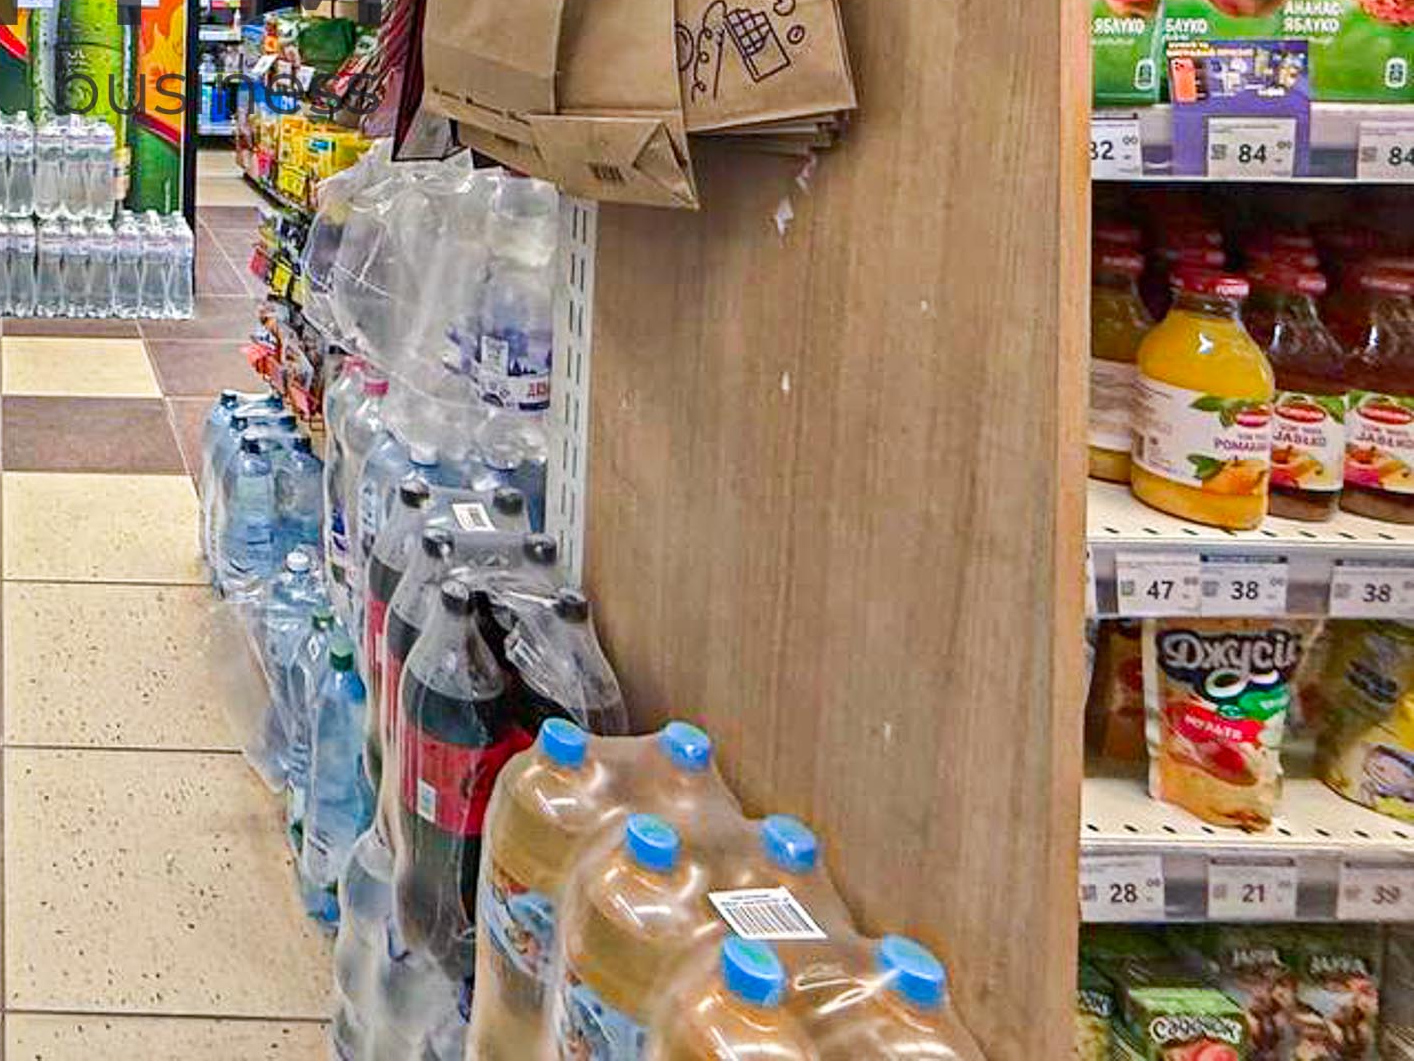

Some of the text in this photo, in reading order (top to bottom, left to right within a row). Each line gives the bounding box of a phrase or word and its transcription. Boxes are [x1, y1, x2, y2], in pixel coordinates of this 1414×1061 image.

[1165, 18, 1208, 34] БЛУКО
[1238, 144, 1267, 164] 84
[1146, 581, 1175, 600] 47
[1230, 581, 1260, 600] 38
[1362, 583, 1392, 603] 38
[1109, 883, 1138, 903] 28
[1241, 883, 1266, 903] 21
